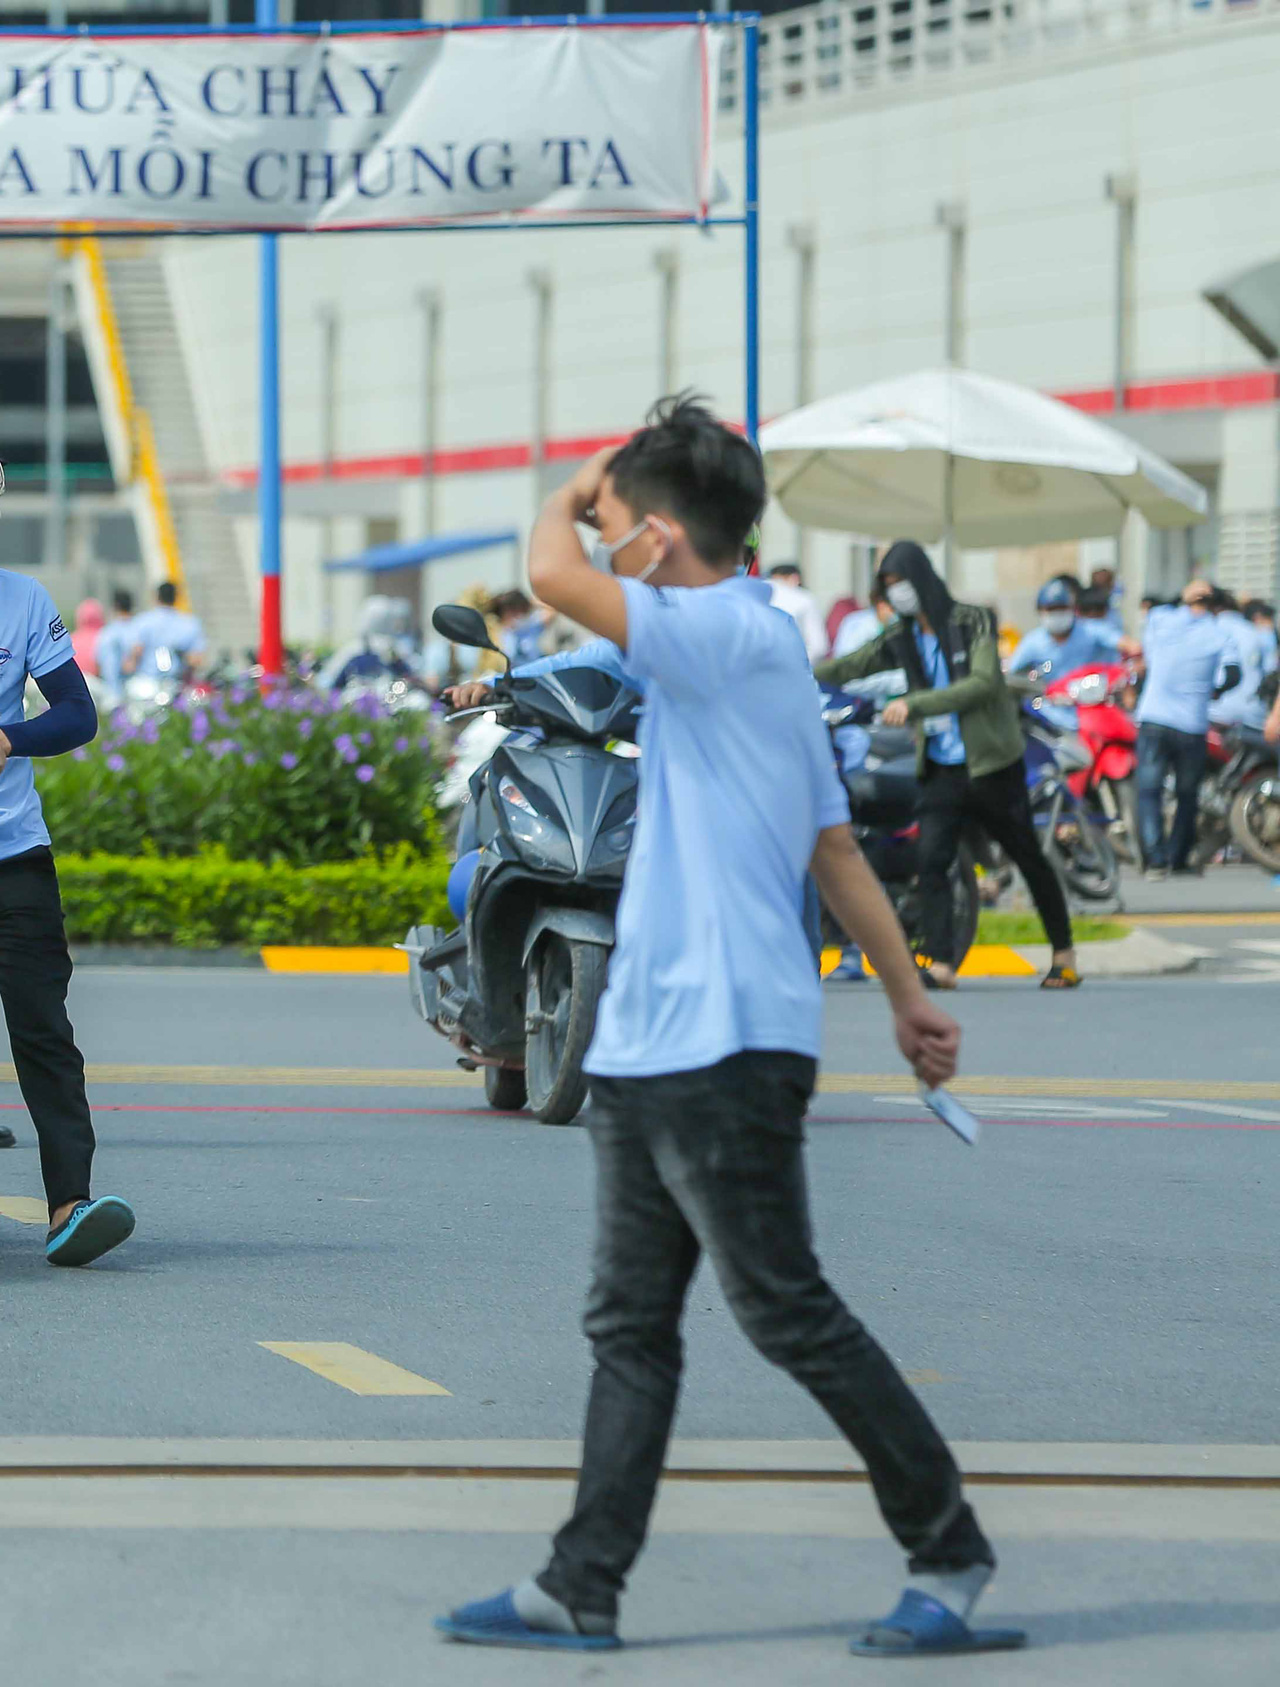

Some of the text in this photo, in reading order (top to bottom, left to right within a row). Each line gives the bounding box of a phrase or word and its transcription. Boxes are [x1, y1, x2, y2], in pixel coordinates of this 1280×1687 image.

[200, 48, 401, 117] CHÁY
[66, 118, 214, 199] MỖI
[245, 132, 519, 201] CHÚNG
[541, 136, 633, 188] TA
